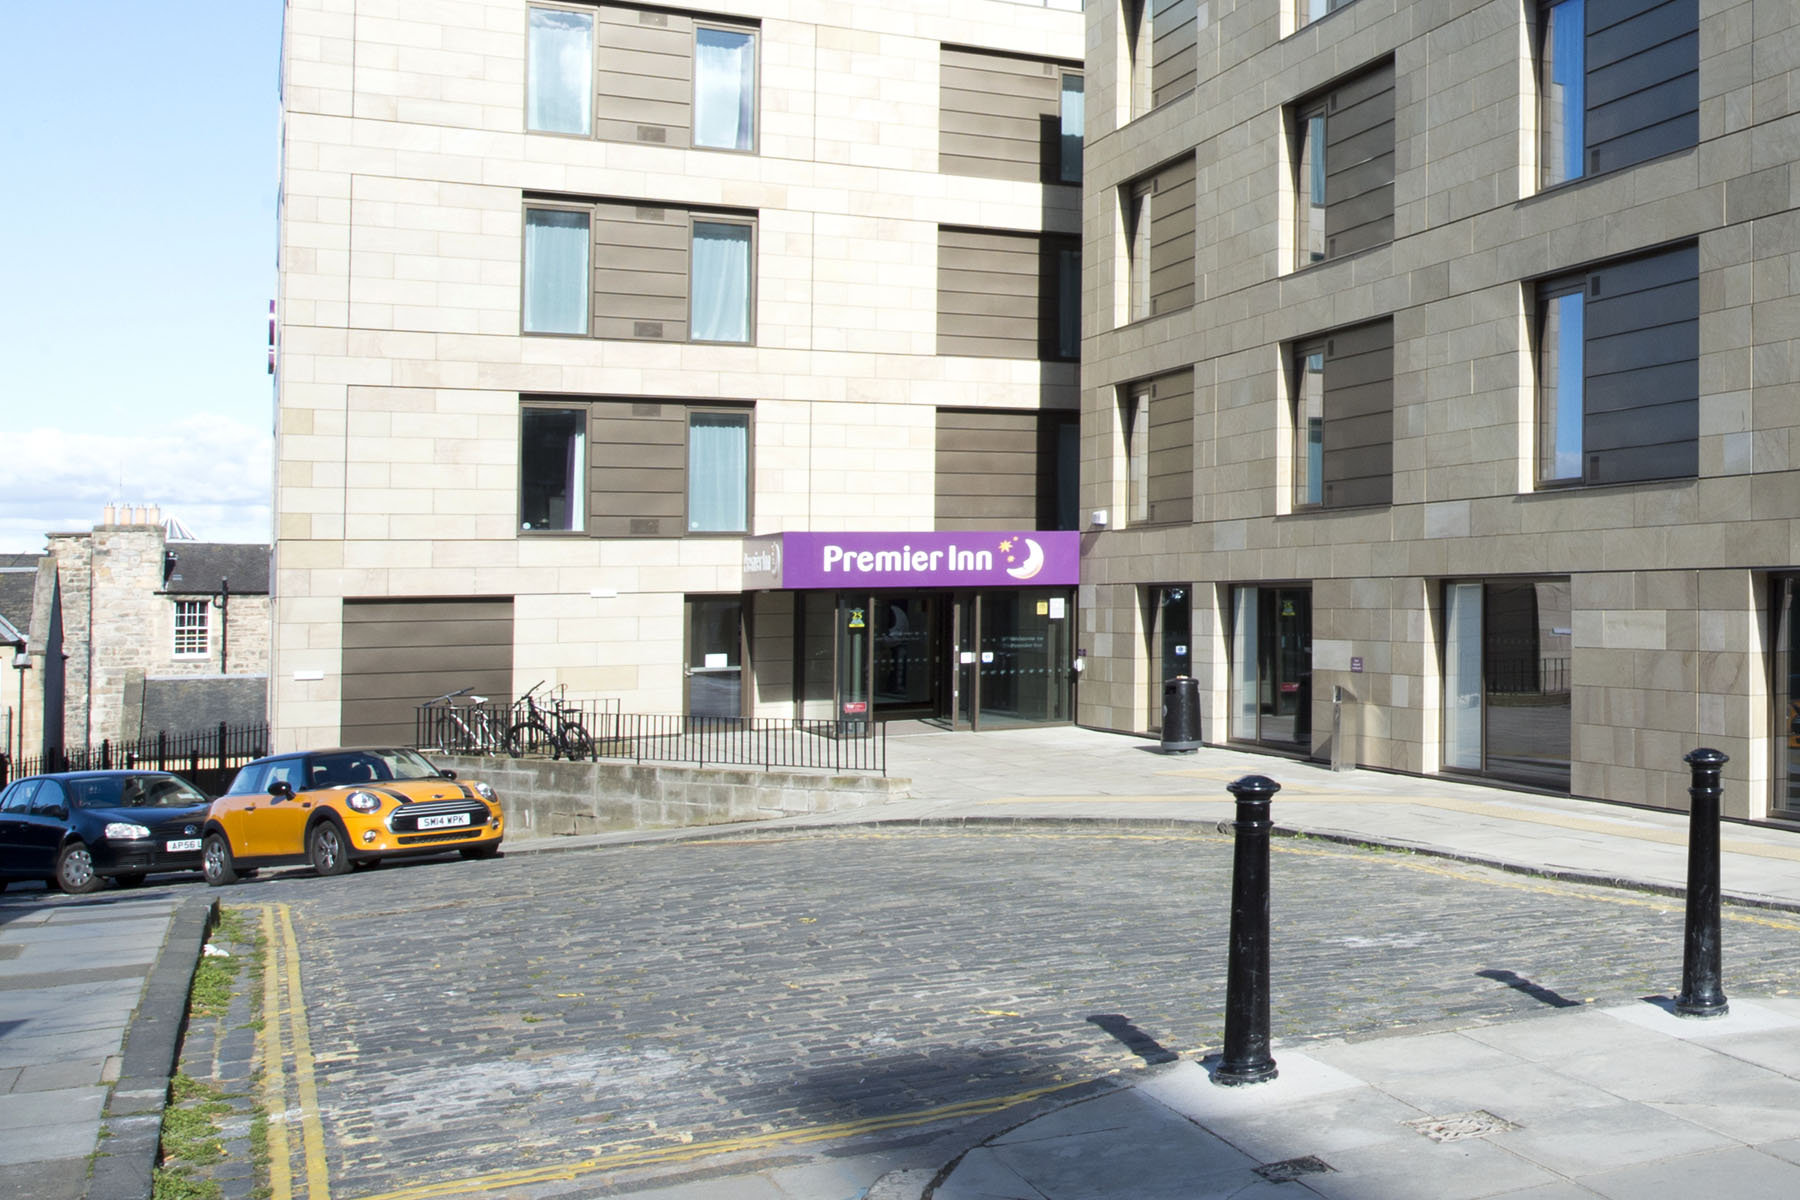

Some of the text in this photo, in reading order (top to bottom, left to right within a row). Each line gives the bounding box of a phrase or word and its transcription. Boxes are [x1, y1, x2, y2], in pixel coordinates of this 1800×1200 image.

[823, 544, 993, 573] Premier Inn
[446, 814, 465, 825] WPK
[171, 841, 196, 850] AP56
